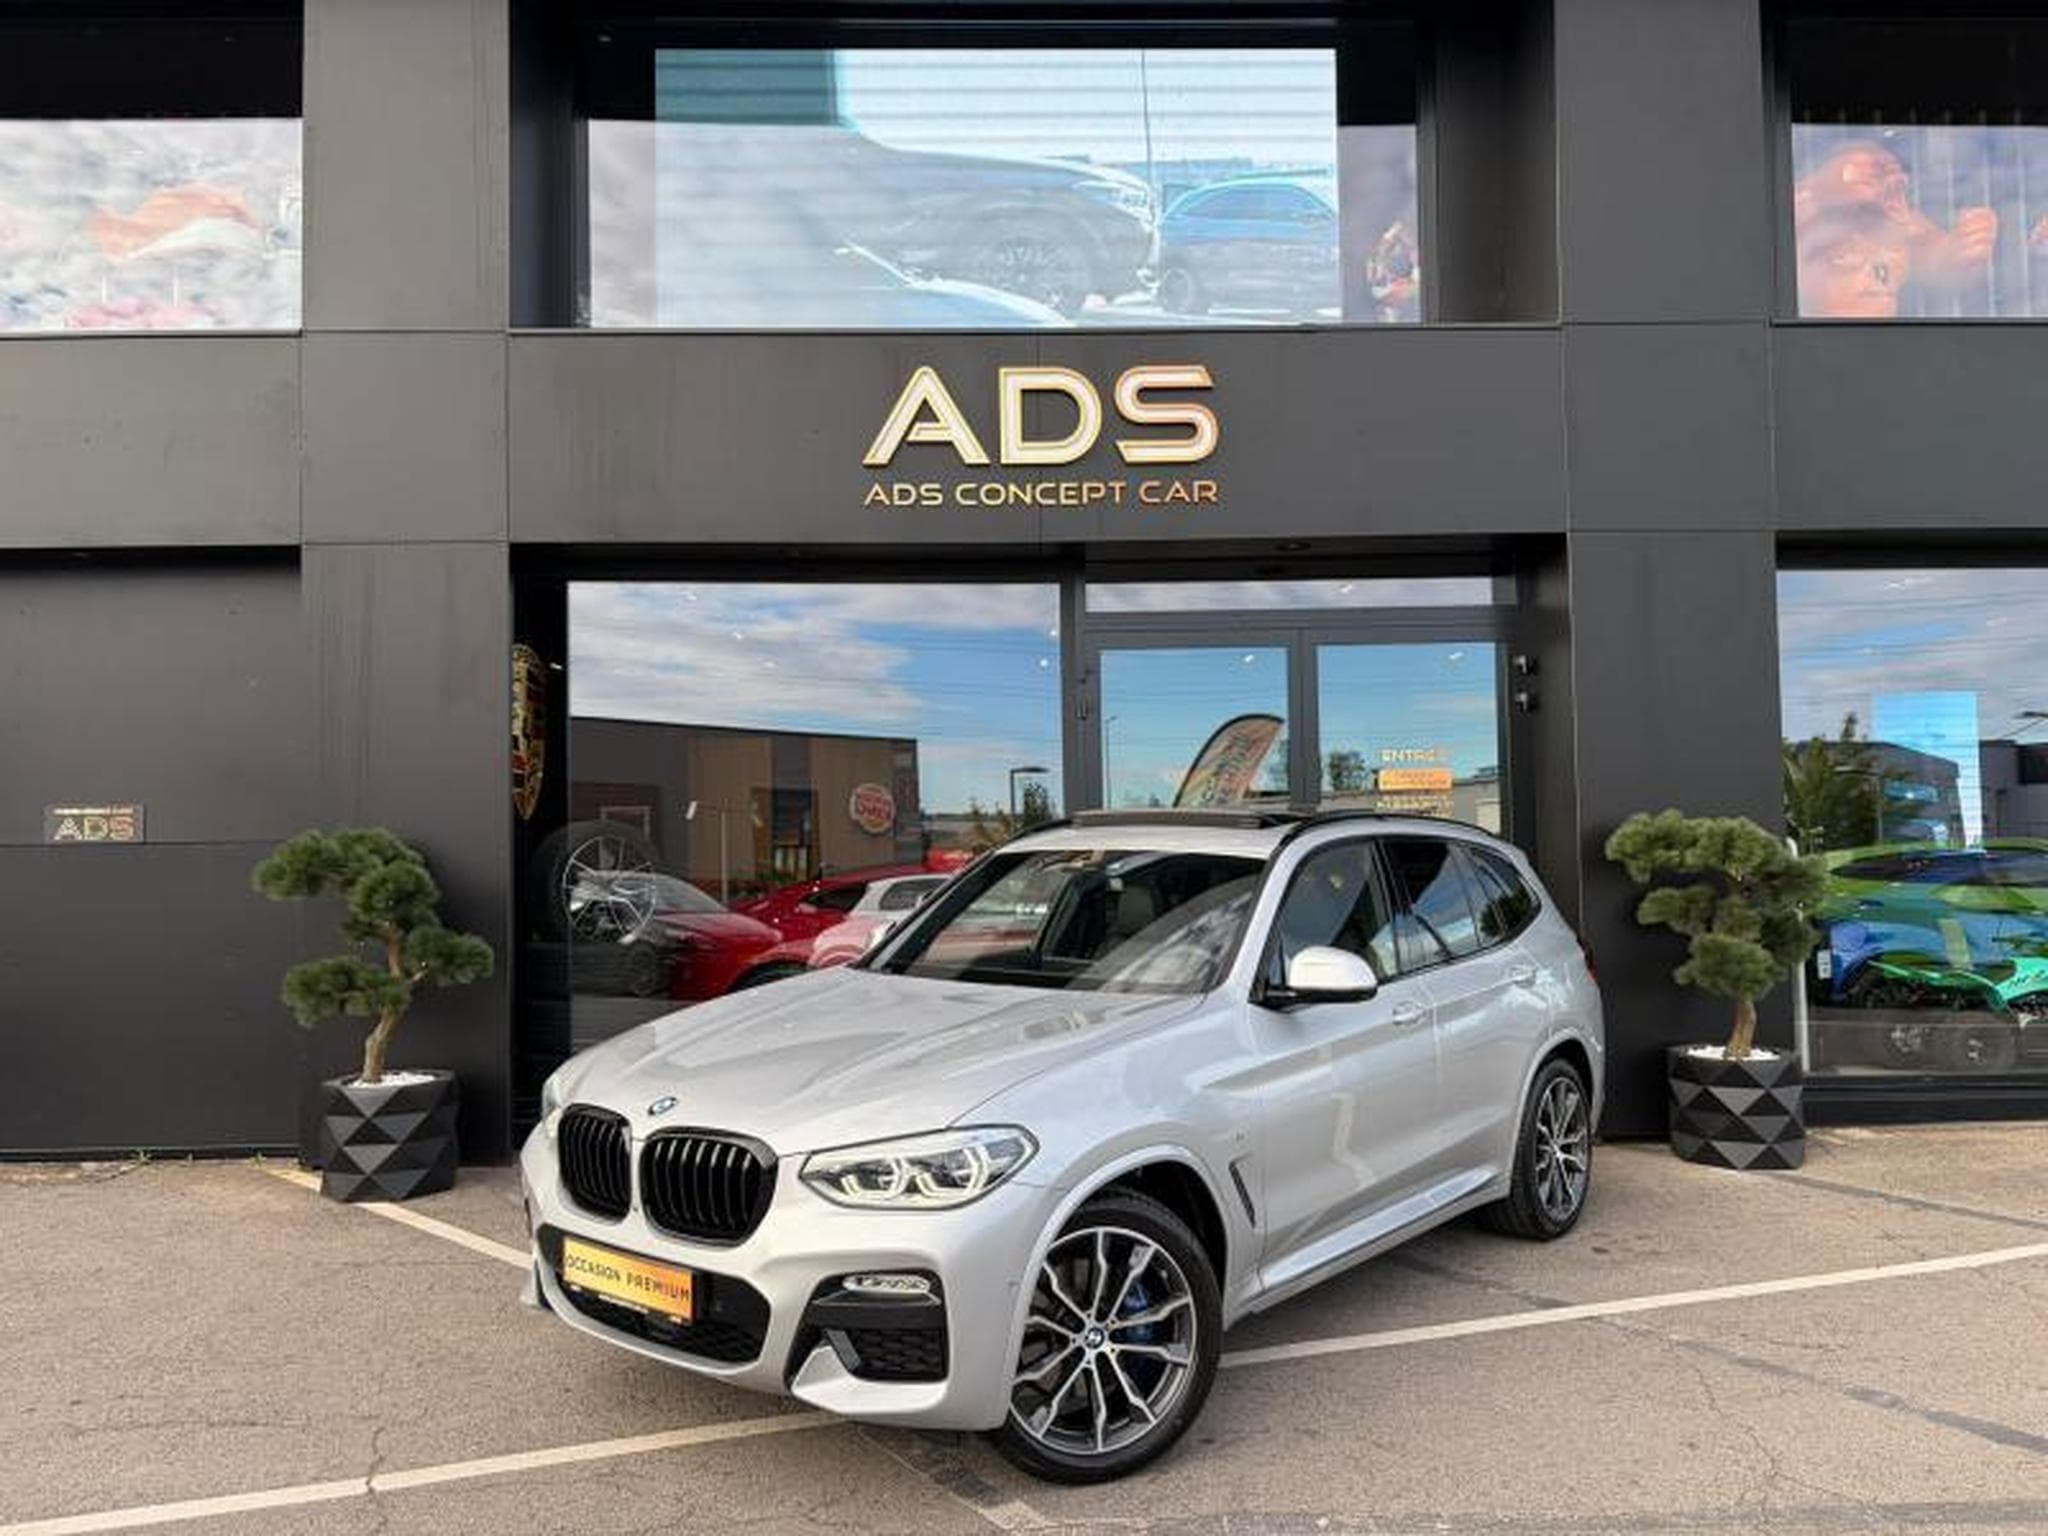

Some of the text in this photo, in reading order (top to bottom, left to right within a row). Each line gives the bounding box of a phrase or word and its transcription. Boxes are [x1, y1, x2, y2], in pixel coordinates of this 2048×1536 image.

[862, 365, 1219, 466] ADS
[864, 480, 1219, 506] ADS CONCEPT CAR
[53, 816, 134, 841] ADS
[565, 1254, 690, 1302] OCCASION PREMIUM
